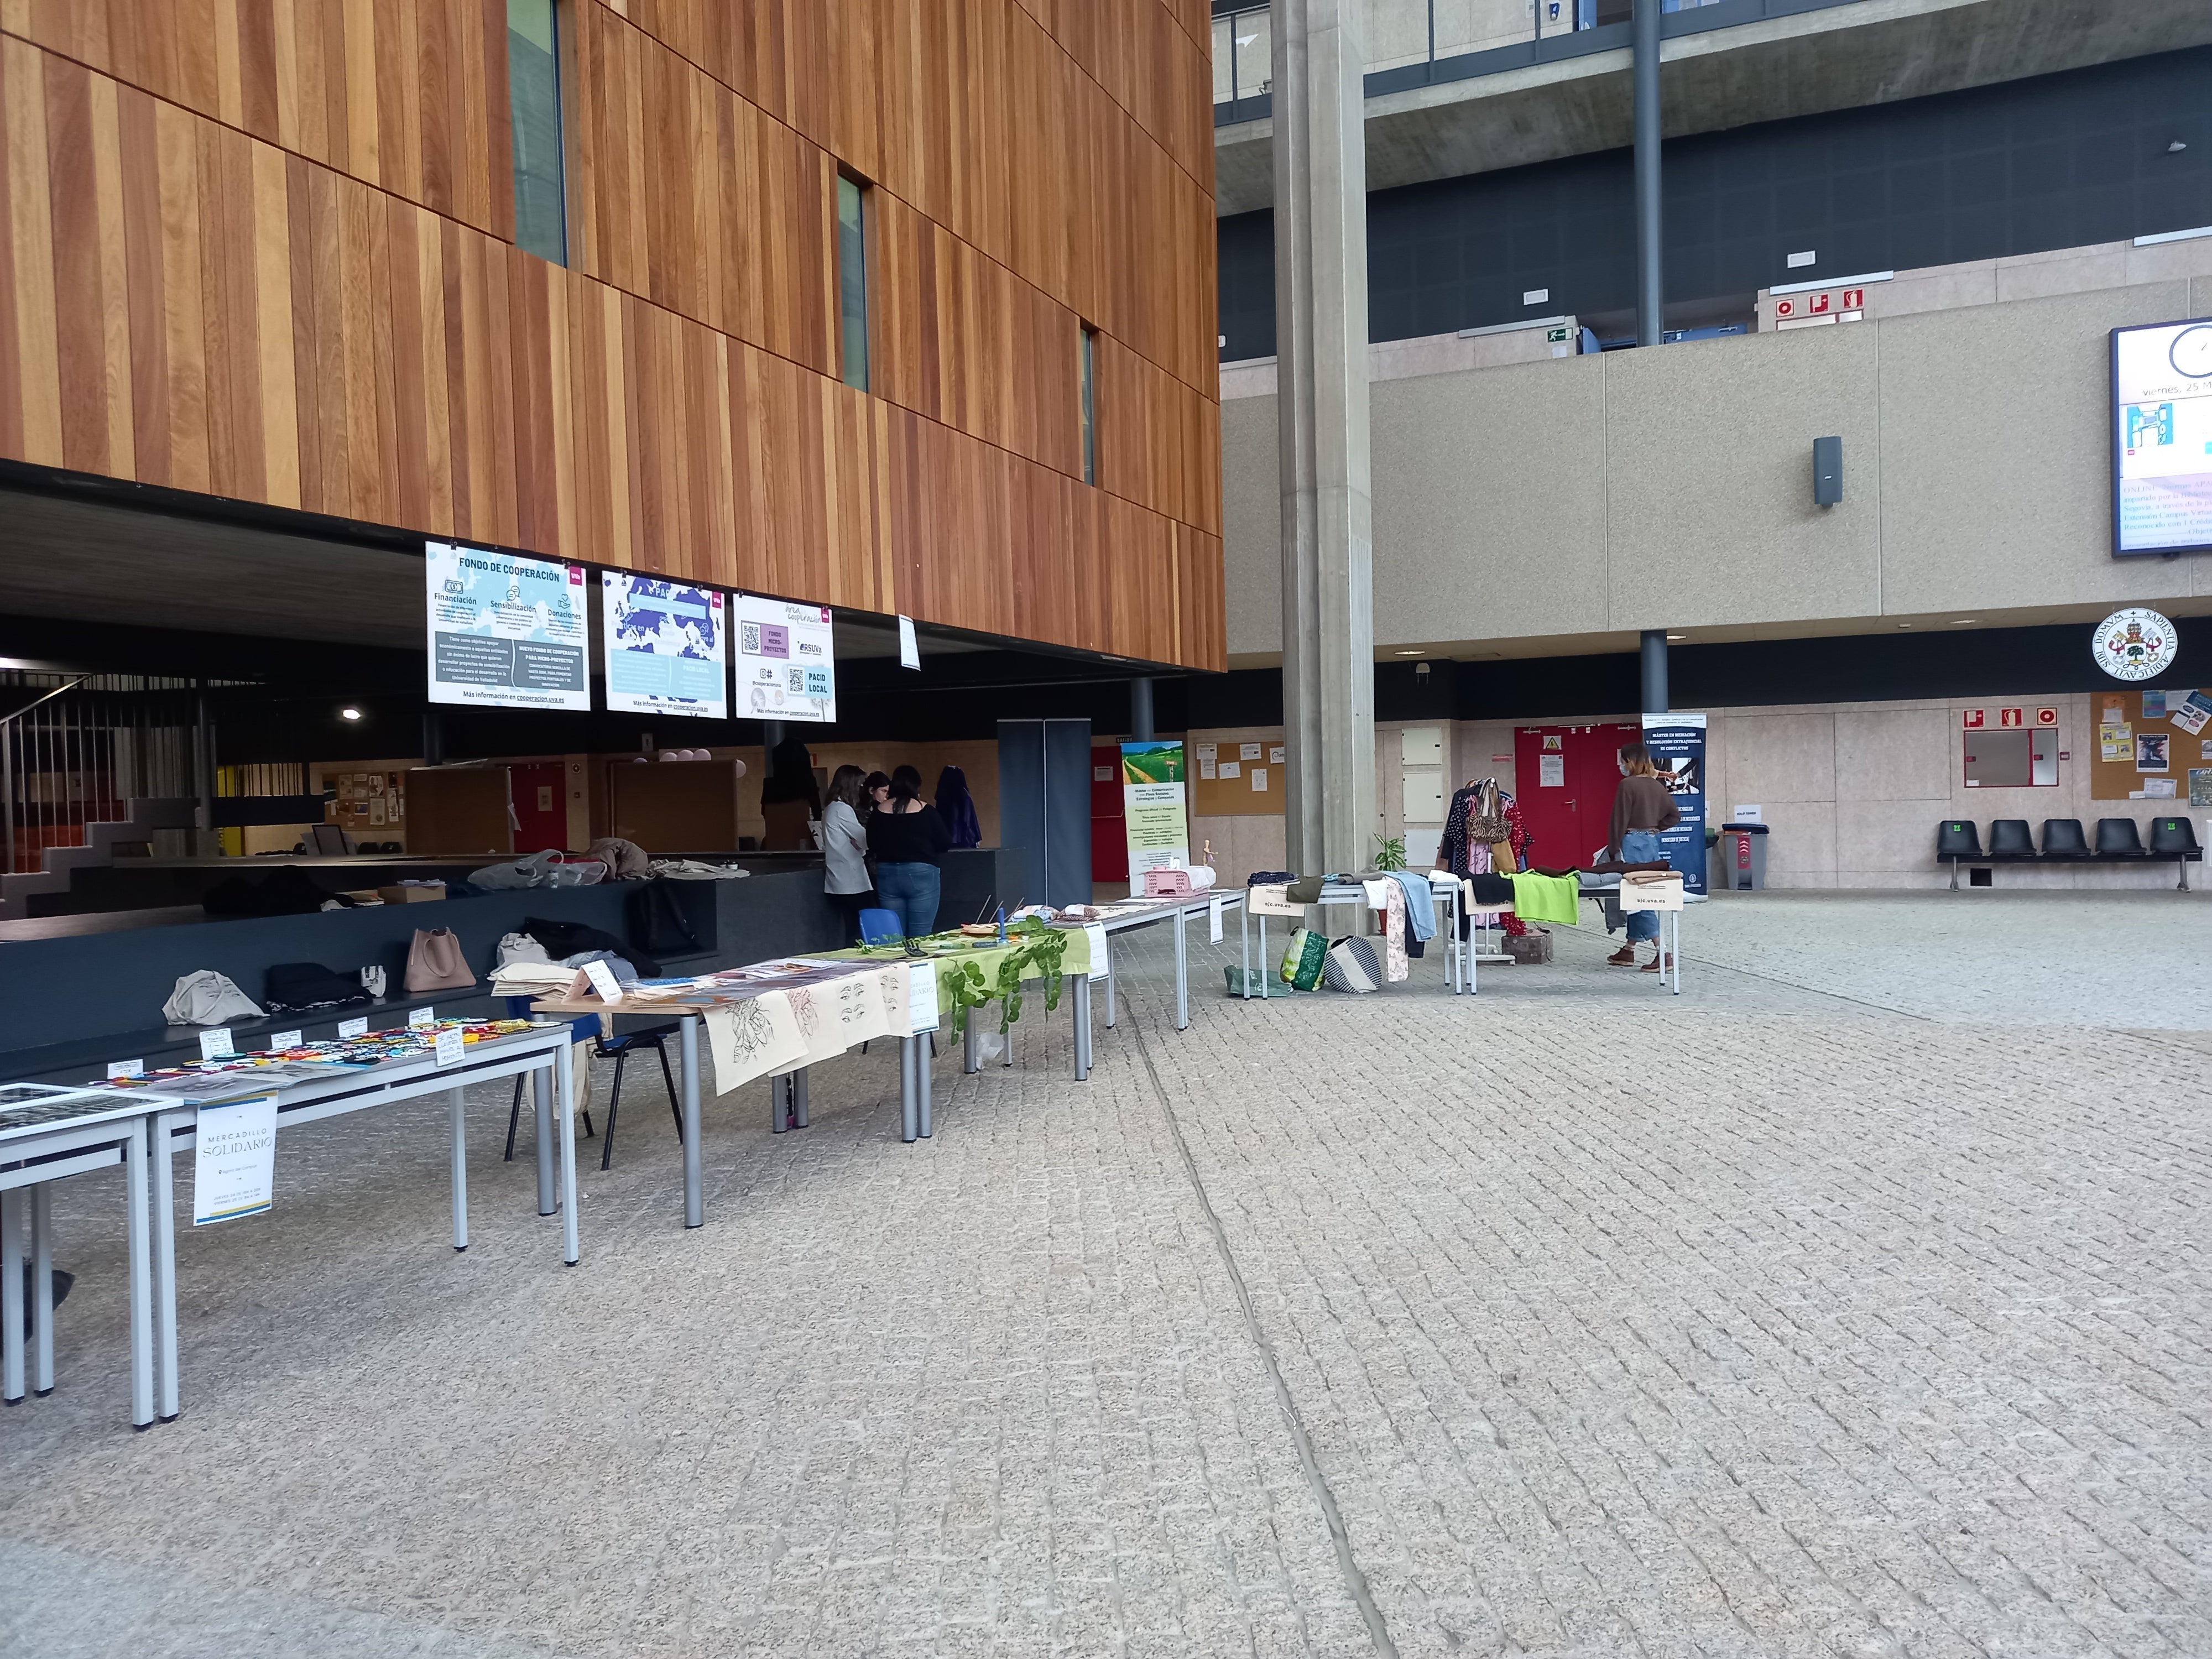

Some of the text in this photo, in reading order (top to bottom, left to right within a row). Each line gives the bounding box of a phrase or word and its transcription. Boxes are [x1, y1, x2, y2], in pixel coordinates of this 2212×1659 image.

[2143, 387, 2181, 396] viernes,
[2187, 383, 2199, 392] 25
[460, 557, 560, 582] FONDO DE COOPERACIÓN
[435, 593, 477, 605] Financiación
[491, 600, 536, 613] Sensibilización
[548, 609, 581, 620] Donaciones
[2096, 651, 2110, 668] SIBI
[808, 673, 825, 681] PACID
[809, 685, 827, 693] LOCAL
[517, 695, 565, 703] cooperacion.uva.es
[208, 1128, 267, 1143] MERCADILLO
[202, 1136, 272, 1158] SOLIDARIO
